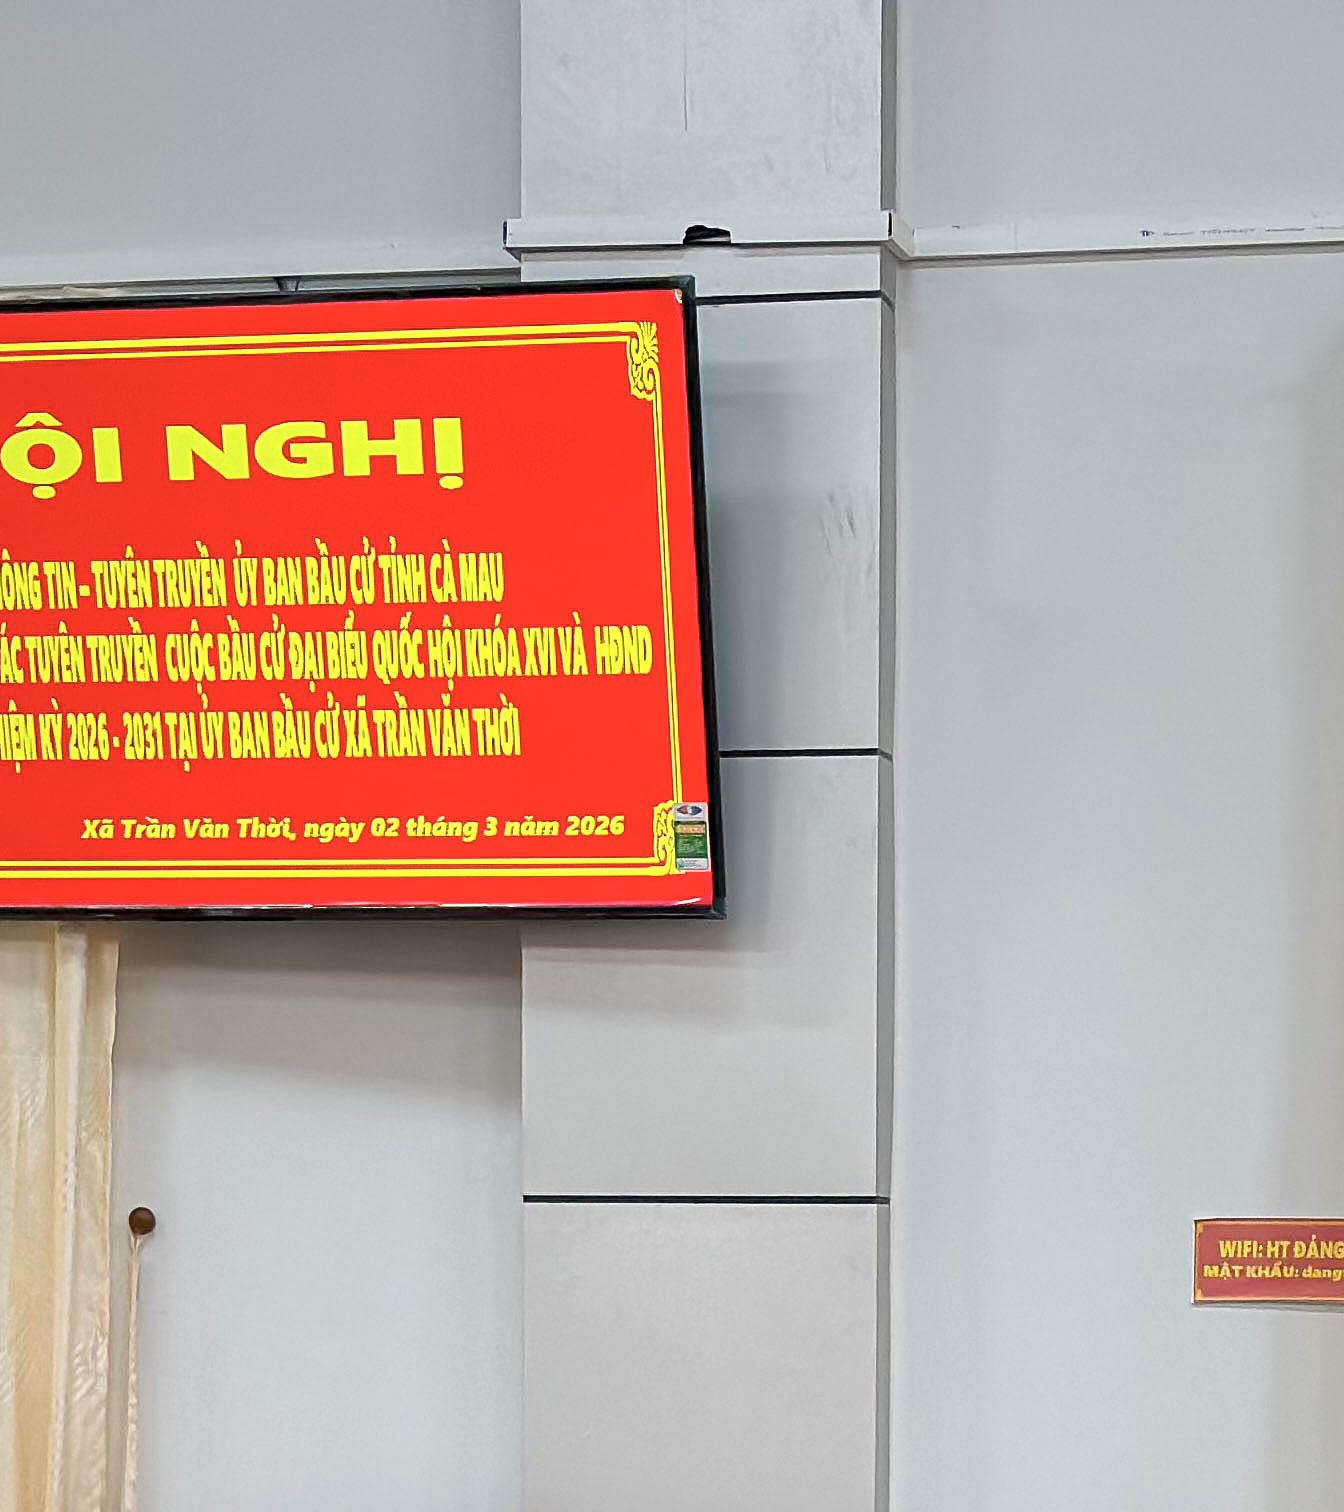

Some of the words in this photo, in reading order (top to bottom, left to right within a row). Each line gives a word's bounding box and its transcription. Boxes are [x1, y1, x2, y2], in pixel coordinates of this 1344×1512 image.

[165, 417, 465, 490] NGHỊ
[43, 561, 78, 609] TIN
[91, 545, 153, 608] TUYÊN
[153, 540, 227, 608] TRUYỀN
[233, 539, 258, 607] ỦY
[262, 556, 304, 606] BAN
[305, 537, 347, 605] BẦU
[349, 536, 376, 605] CỬ
[377, 535, 427, 604] TỈNH
[429, 538, 458, 603] CÀ
[458, 552, 505, 603] MAU
[24, 621, 86, 683] TUYÊN
[86, 616, 159, 683] TRUYỀN
[165, 619, 216, 695] CUỘC
[216, 615, 257, 681] BẦU
[259, 613, 286, 680] CỬ
[288, 631, 325, 693] ĐẠI
[326, 609, 368, 680] BIỂU
[372, 611, 425, 685] QUỐC
[427, 614, 463, 691] HỘI
[464, 613, 522, 678] KHÓA
[522, 627, 558, 676] XVI
[557, 611, 589, 676] VÀ
[594, 624, 653, 675] HĐND
[38, 697, 63, 761] KỲ
[66, 712, 110, 761] 2026
[122, 711, 164, 760] 2031
[164, 711, 198, 772] TẠI
[199, 693, 224, 759] ỦY
[227, 711, 271, 759] BAN
[271, 692, 311, 759] BẦU
[314, 691, 341, 759] CỬ
[343, 694, 373, 758] XÃ
[372, 691, 427, 757] TRẦN
[427, 693, 472, 757] VĂN
[472, 693, 521, 756] THỜI
[80, 818, 115, 839] Xã
[121, 816, 176, 839] Trần
[183, 817, 230, 839] Văn
[236, 816, 296, 842] Thời,
[304, 816, 366, 843] ngày
[370, 817, 400, 837] 02
[406, 815, 478, 843] tháng
[483, 816, 498, 837] 3
[504, 815, 559, 836] năm
[565, 815, 625, 836] 2026
[1203, 1262, 1242, 1280] MẬT
[1246, 1260, 1299, 1278] KHẨU:
[1219, 1240, 1263, 1258] WIFI:
[1266, 1240, 1290, 1258] HT
[1293, 1234, 1344, 1259] ĐẢNG
